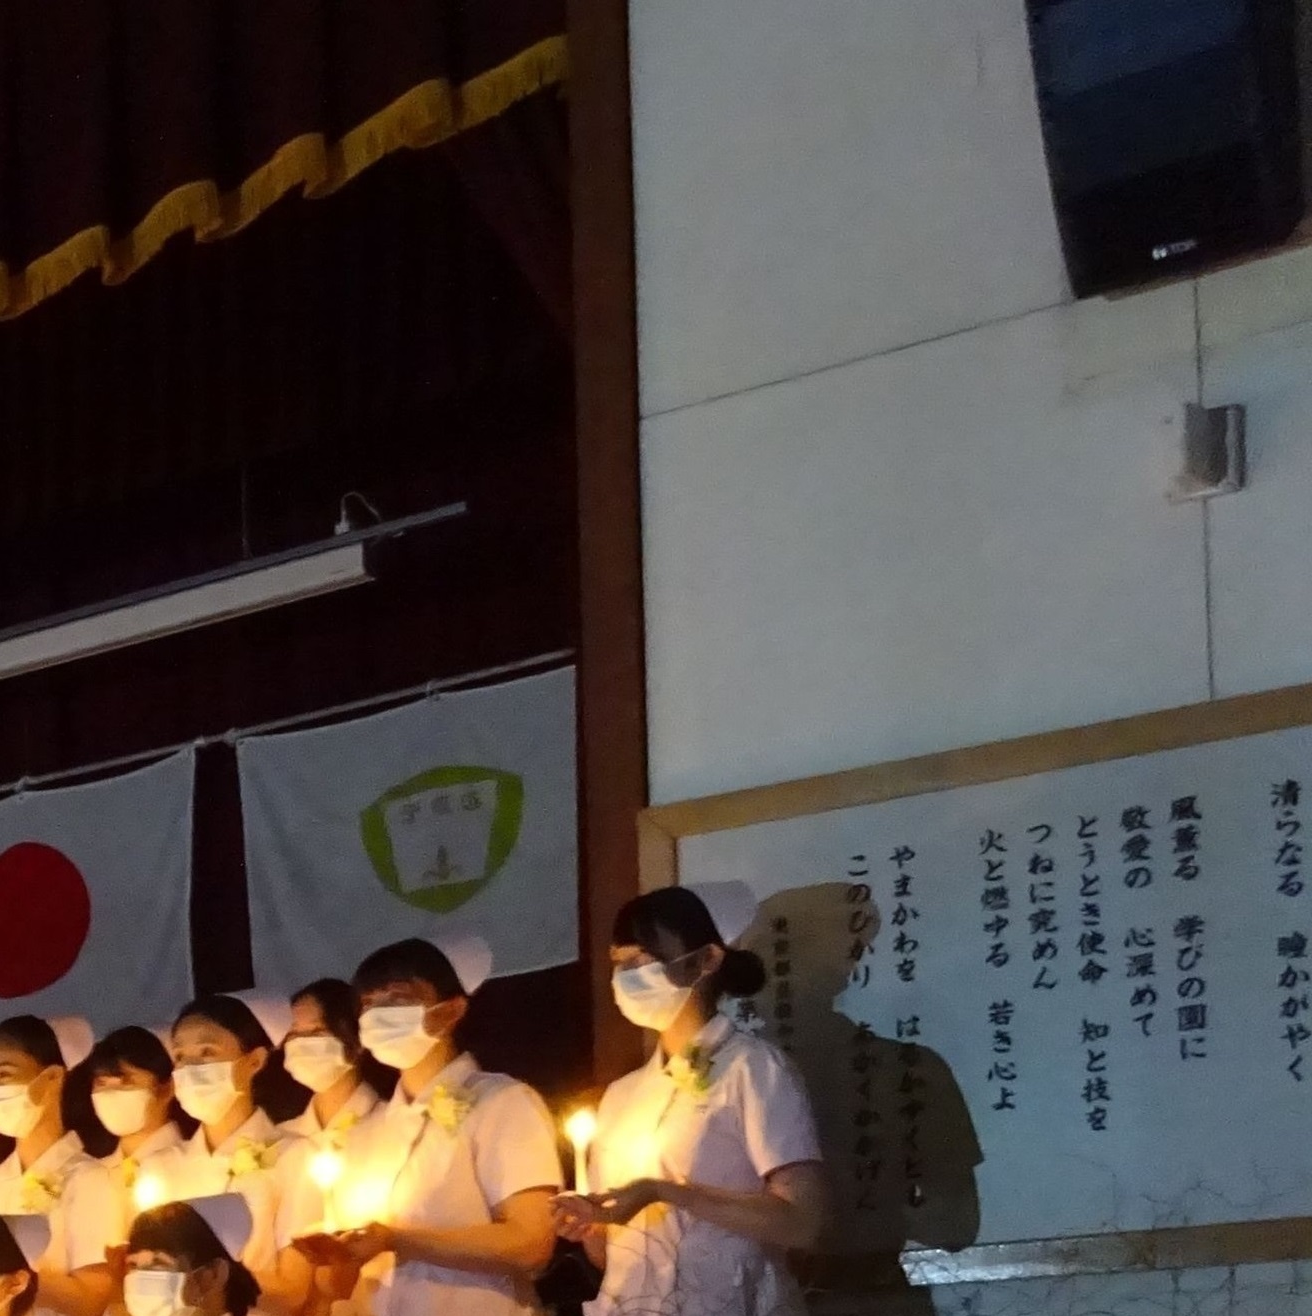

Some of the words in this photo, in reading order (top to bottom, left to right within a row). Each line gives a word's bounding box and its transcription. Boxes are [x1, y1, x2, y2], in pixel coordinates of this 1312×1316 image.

[1077, 815, 1108, 985] とうとき使命
[1121, 805, 1152, 889] 敬愛の
[1170, 795, 1202, 881] 風薫る
[1271, 779, 1304, 898] 清らなる
[846, 854, 875, 989] このひかり
[889, 845, 921, 983] やまかわを
[1026, 823, 1059, 989] つねに究めん
[1124, 928, 1157, 1037] 心深めて
[1174, 915, 1207, 1060] 学びの園に
[1277, 931, 1311, 1082] 瞳かがやく
[987, 999, 1018, 1111] 若き心よ
[1081, 1018, 1111, 1131] 知と技を
